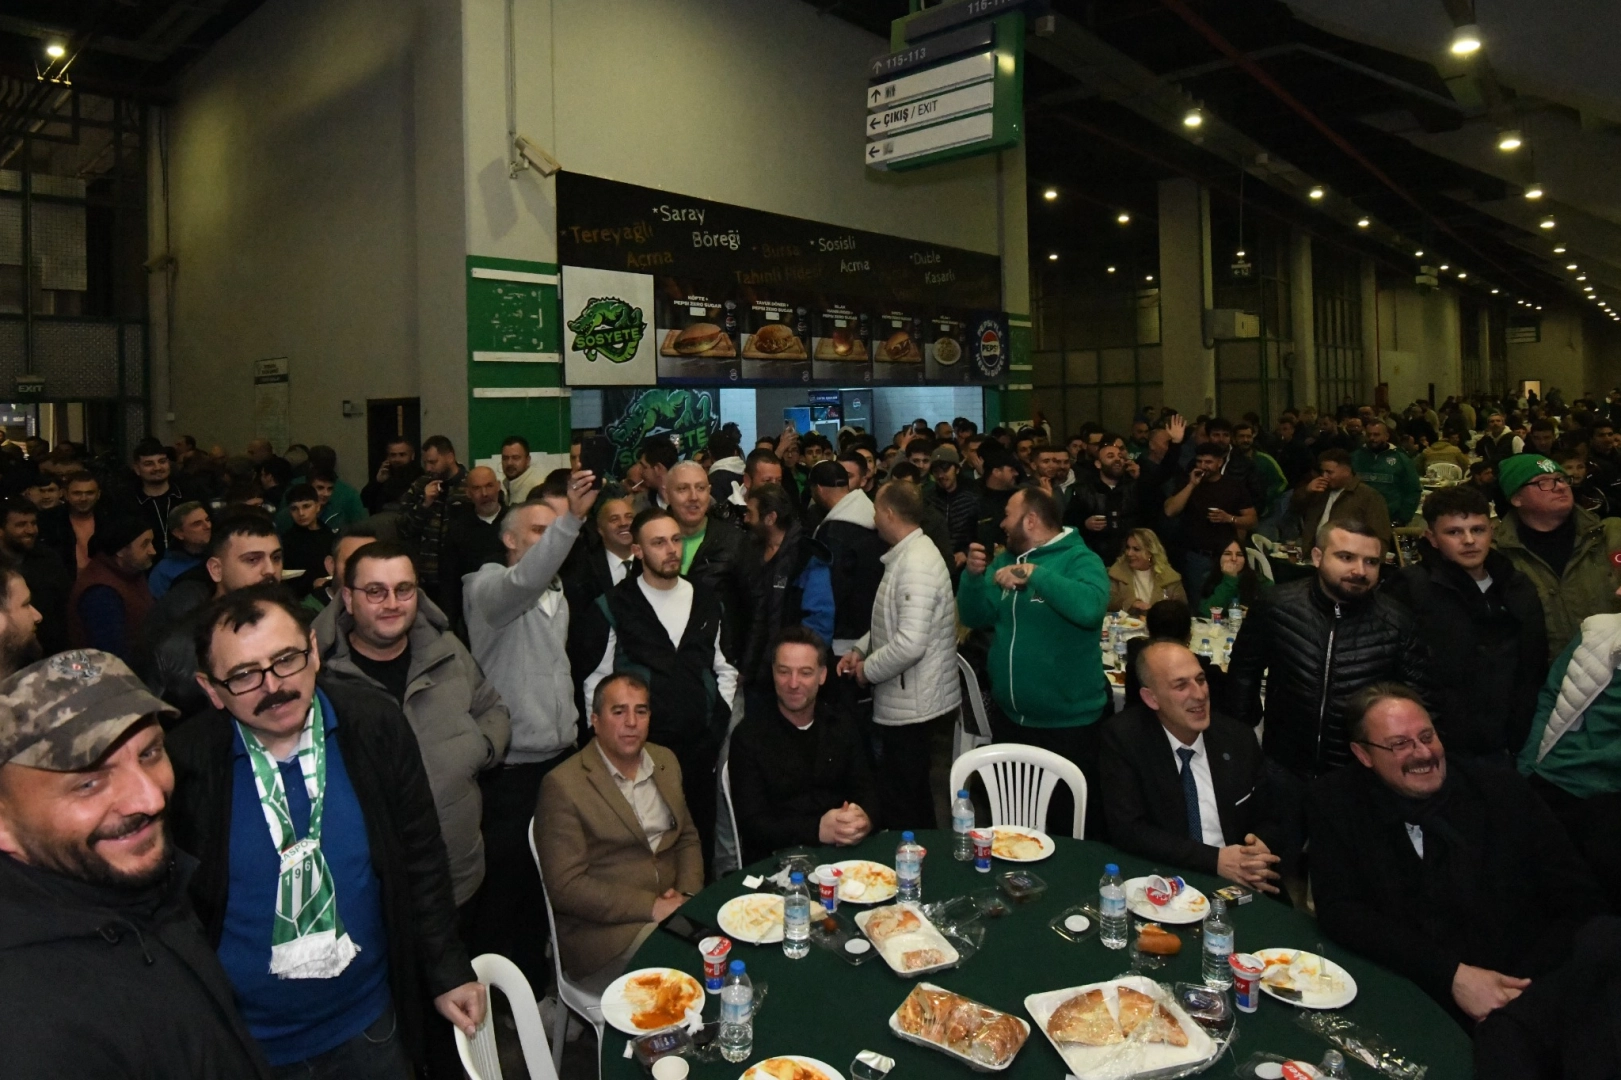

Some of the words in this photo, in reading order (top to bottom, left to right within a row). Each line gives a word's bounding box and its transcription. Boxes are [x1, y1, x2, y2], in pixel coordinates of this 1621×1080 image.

[887, 48, 926, 69] 115-113
[884, 109, 909, 127] ÇIKIŞ
[918, 100, 938, 116] EXIT
[659, 204, 706, 227] Saray
[691, 229, 741, 251] Böreği
[818, 235, 857, 252] Sosisli
[913, 250, 941, 265] Duble
[575, 328, 640, 349] SOSYETE
[18, 384, 43, 393] EXIT
